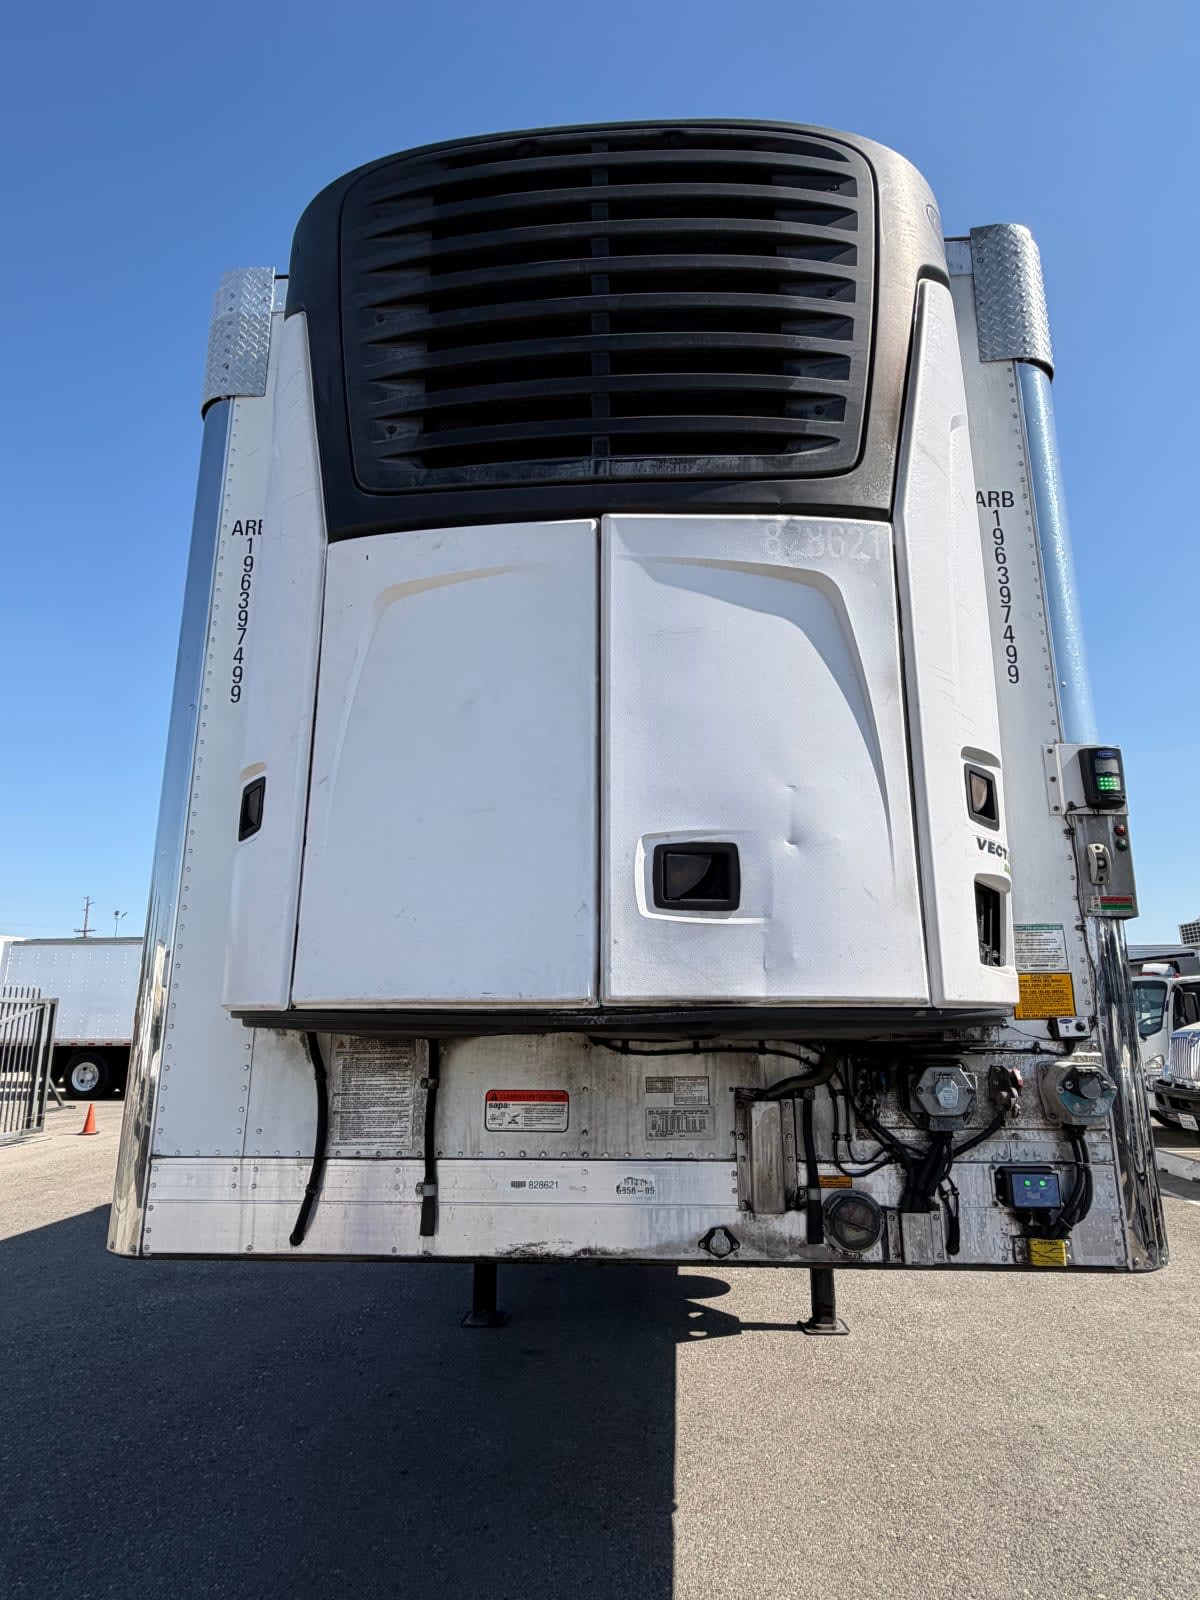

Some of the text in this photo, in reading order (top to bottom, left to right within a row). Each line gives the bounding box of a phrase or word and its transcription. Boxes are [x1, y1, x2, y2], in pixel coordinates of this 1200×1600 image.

[976, 491, 1015, 508] ARB
[230, 537, 254, 704] 196397499
[992, 509, 1020, 684] 196397499
[528, 1180, 559, 1190] 828621
